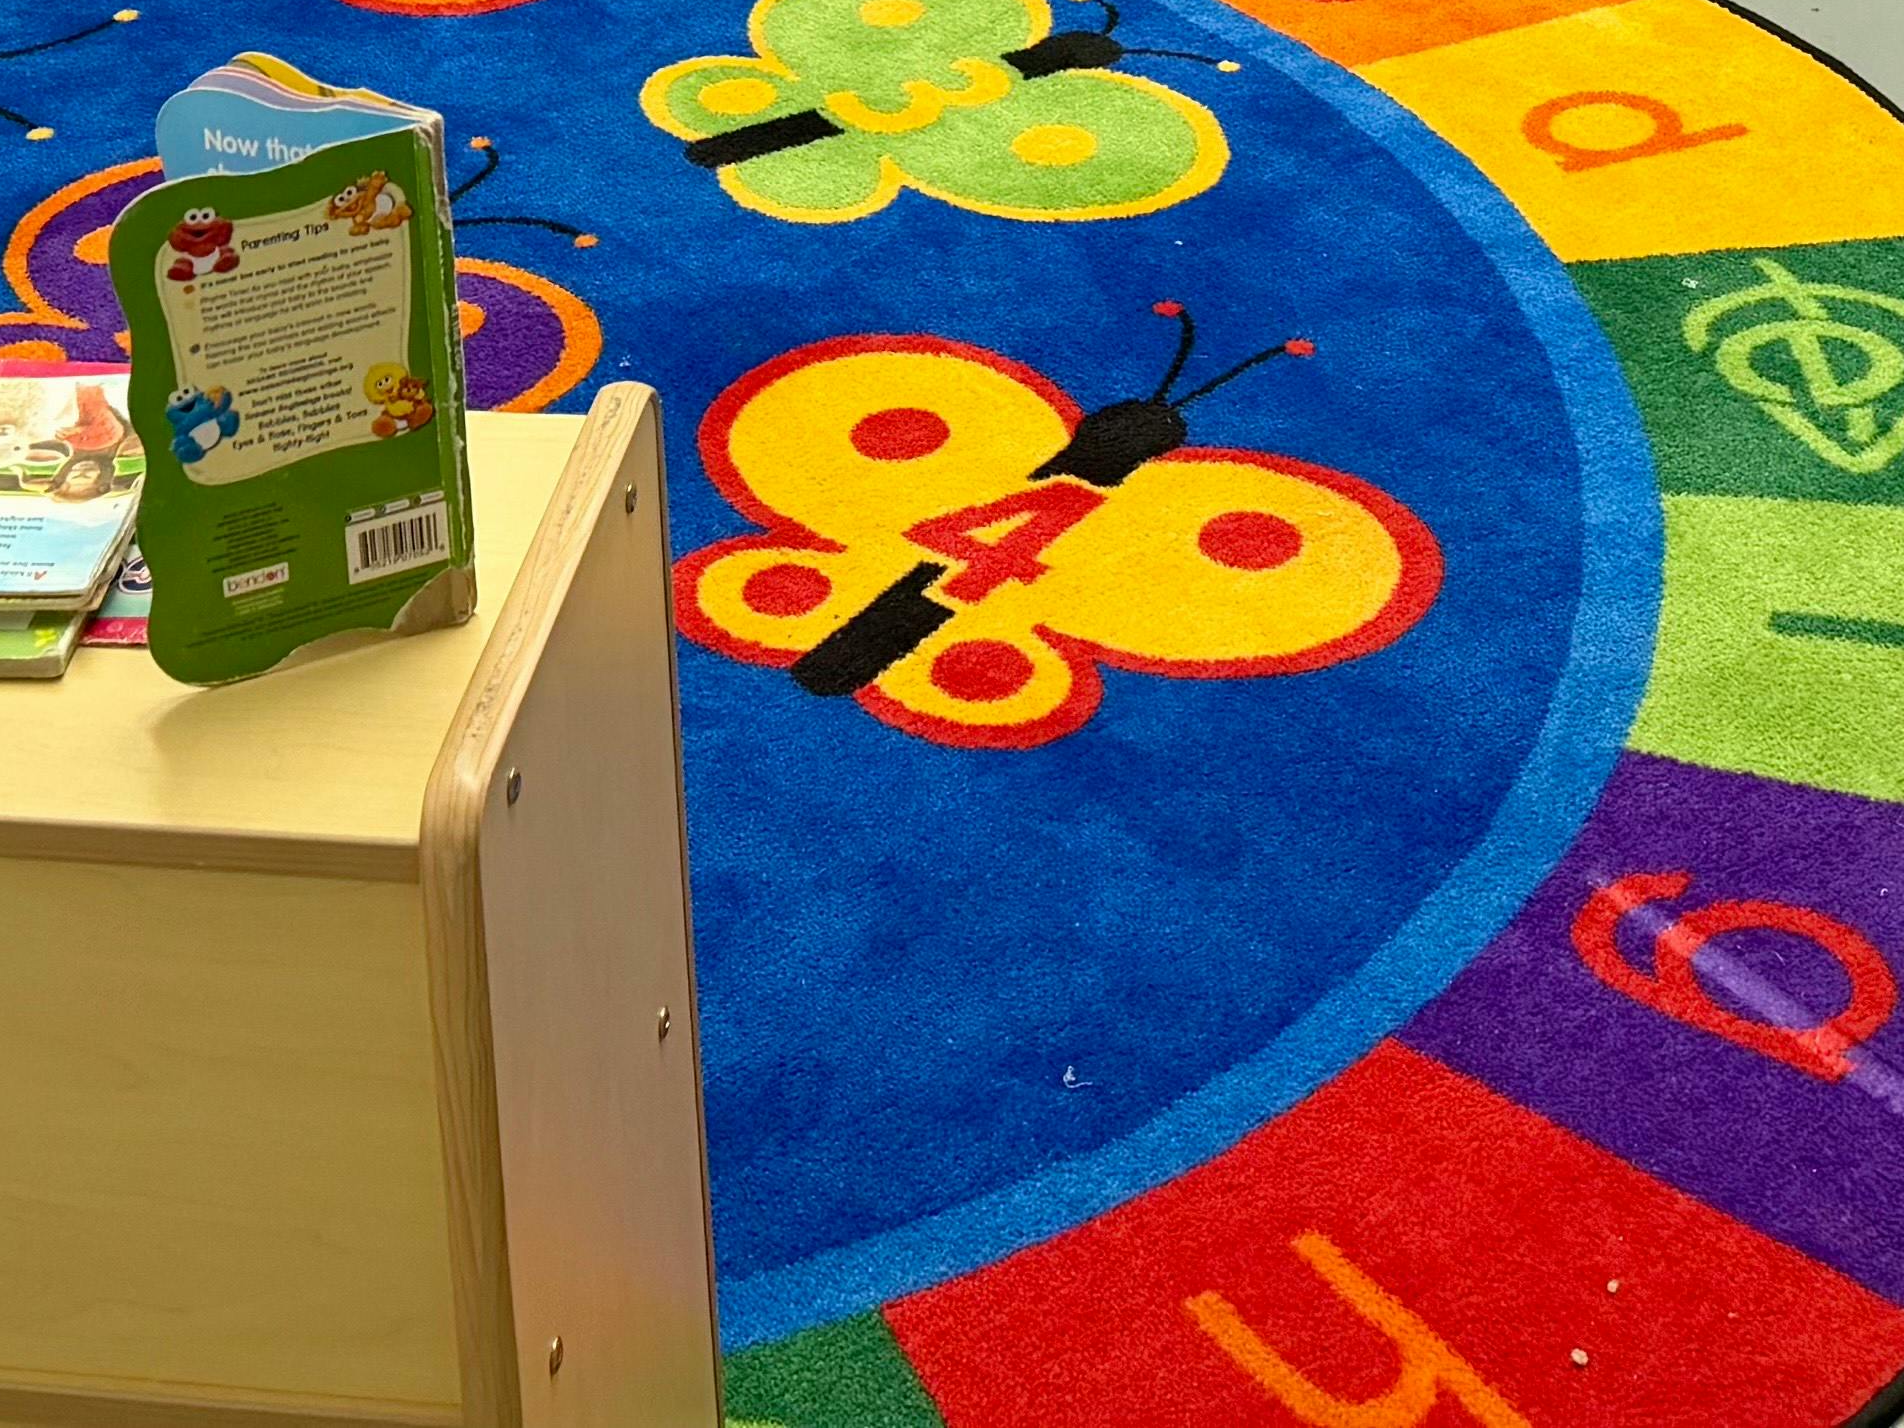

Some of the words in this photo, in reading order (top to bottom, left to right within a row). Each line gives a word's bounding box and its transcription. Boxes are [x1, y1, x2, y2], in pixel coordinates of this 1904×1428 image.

[825, 56, 1014, 134] 3
[1522, 89, 1748, 173] d
[203, 127, 259, 158] Now
[241, 229, 301, 252] Parenting
[304, 222, 330, 236] Tips
[226, 565, 286, 593] bendon
[904, 477, 1108, 604] 4
[1568, 869, 1898, 1082] g
